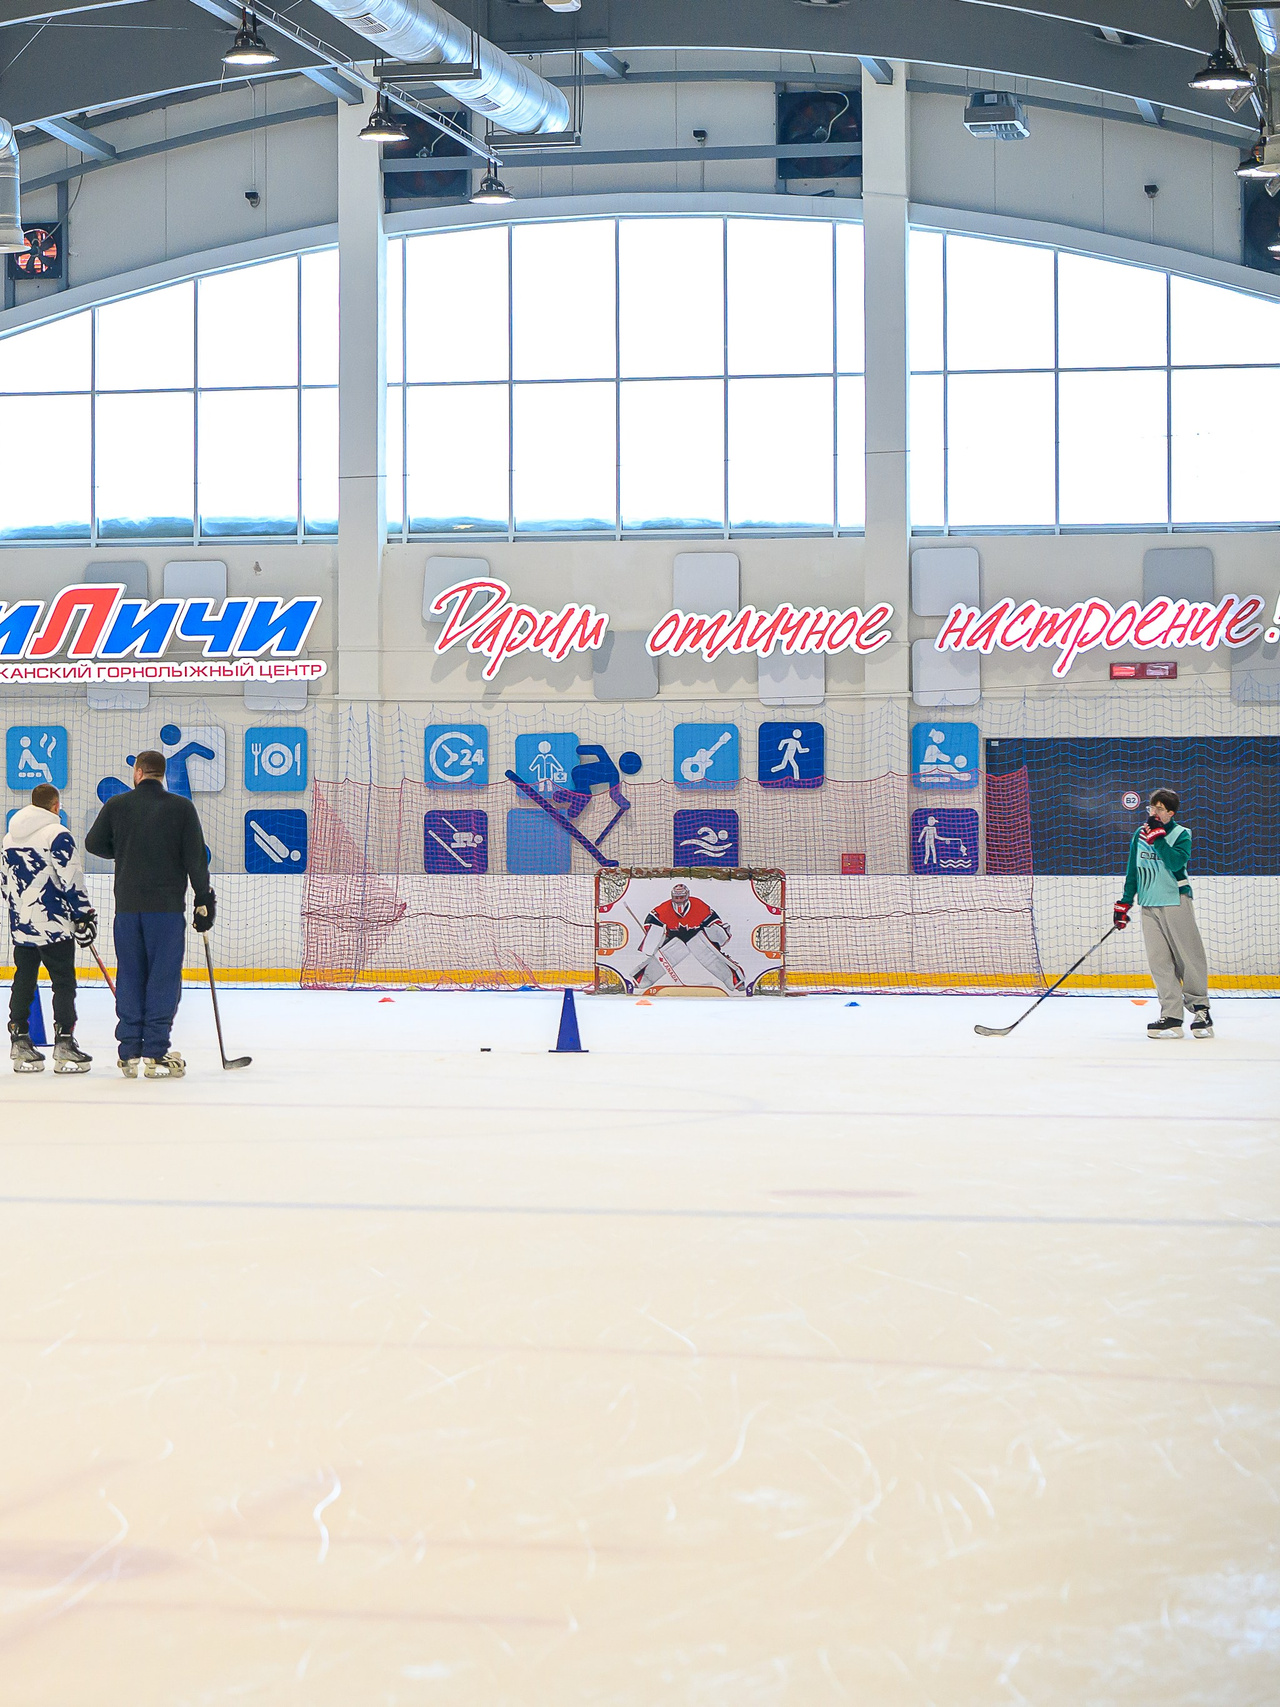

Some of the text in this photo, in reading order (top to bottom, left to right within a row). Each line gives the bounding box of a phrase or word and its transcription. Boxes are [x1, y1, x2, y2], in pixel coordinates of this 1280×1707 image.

[433, 581, 1280, 677] Дарим отличное настроение
[97, 662, 254, 679] ГОРНОЛЫЖНЫЙ
[259, 664, 323, 679] ЦЕНТР
[460, 749, 485, 766] 24
[662, 961, 679, 983] CANADA
